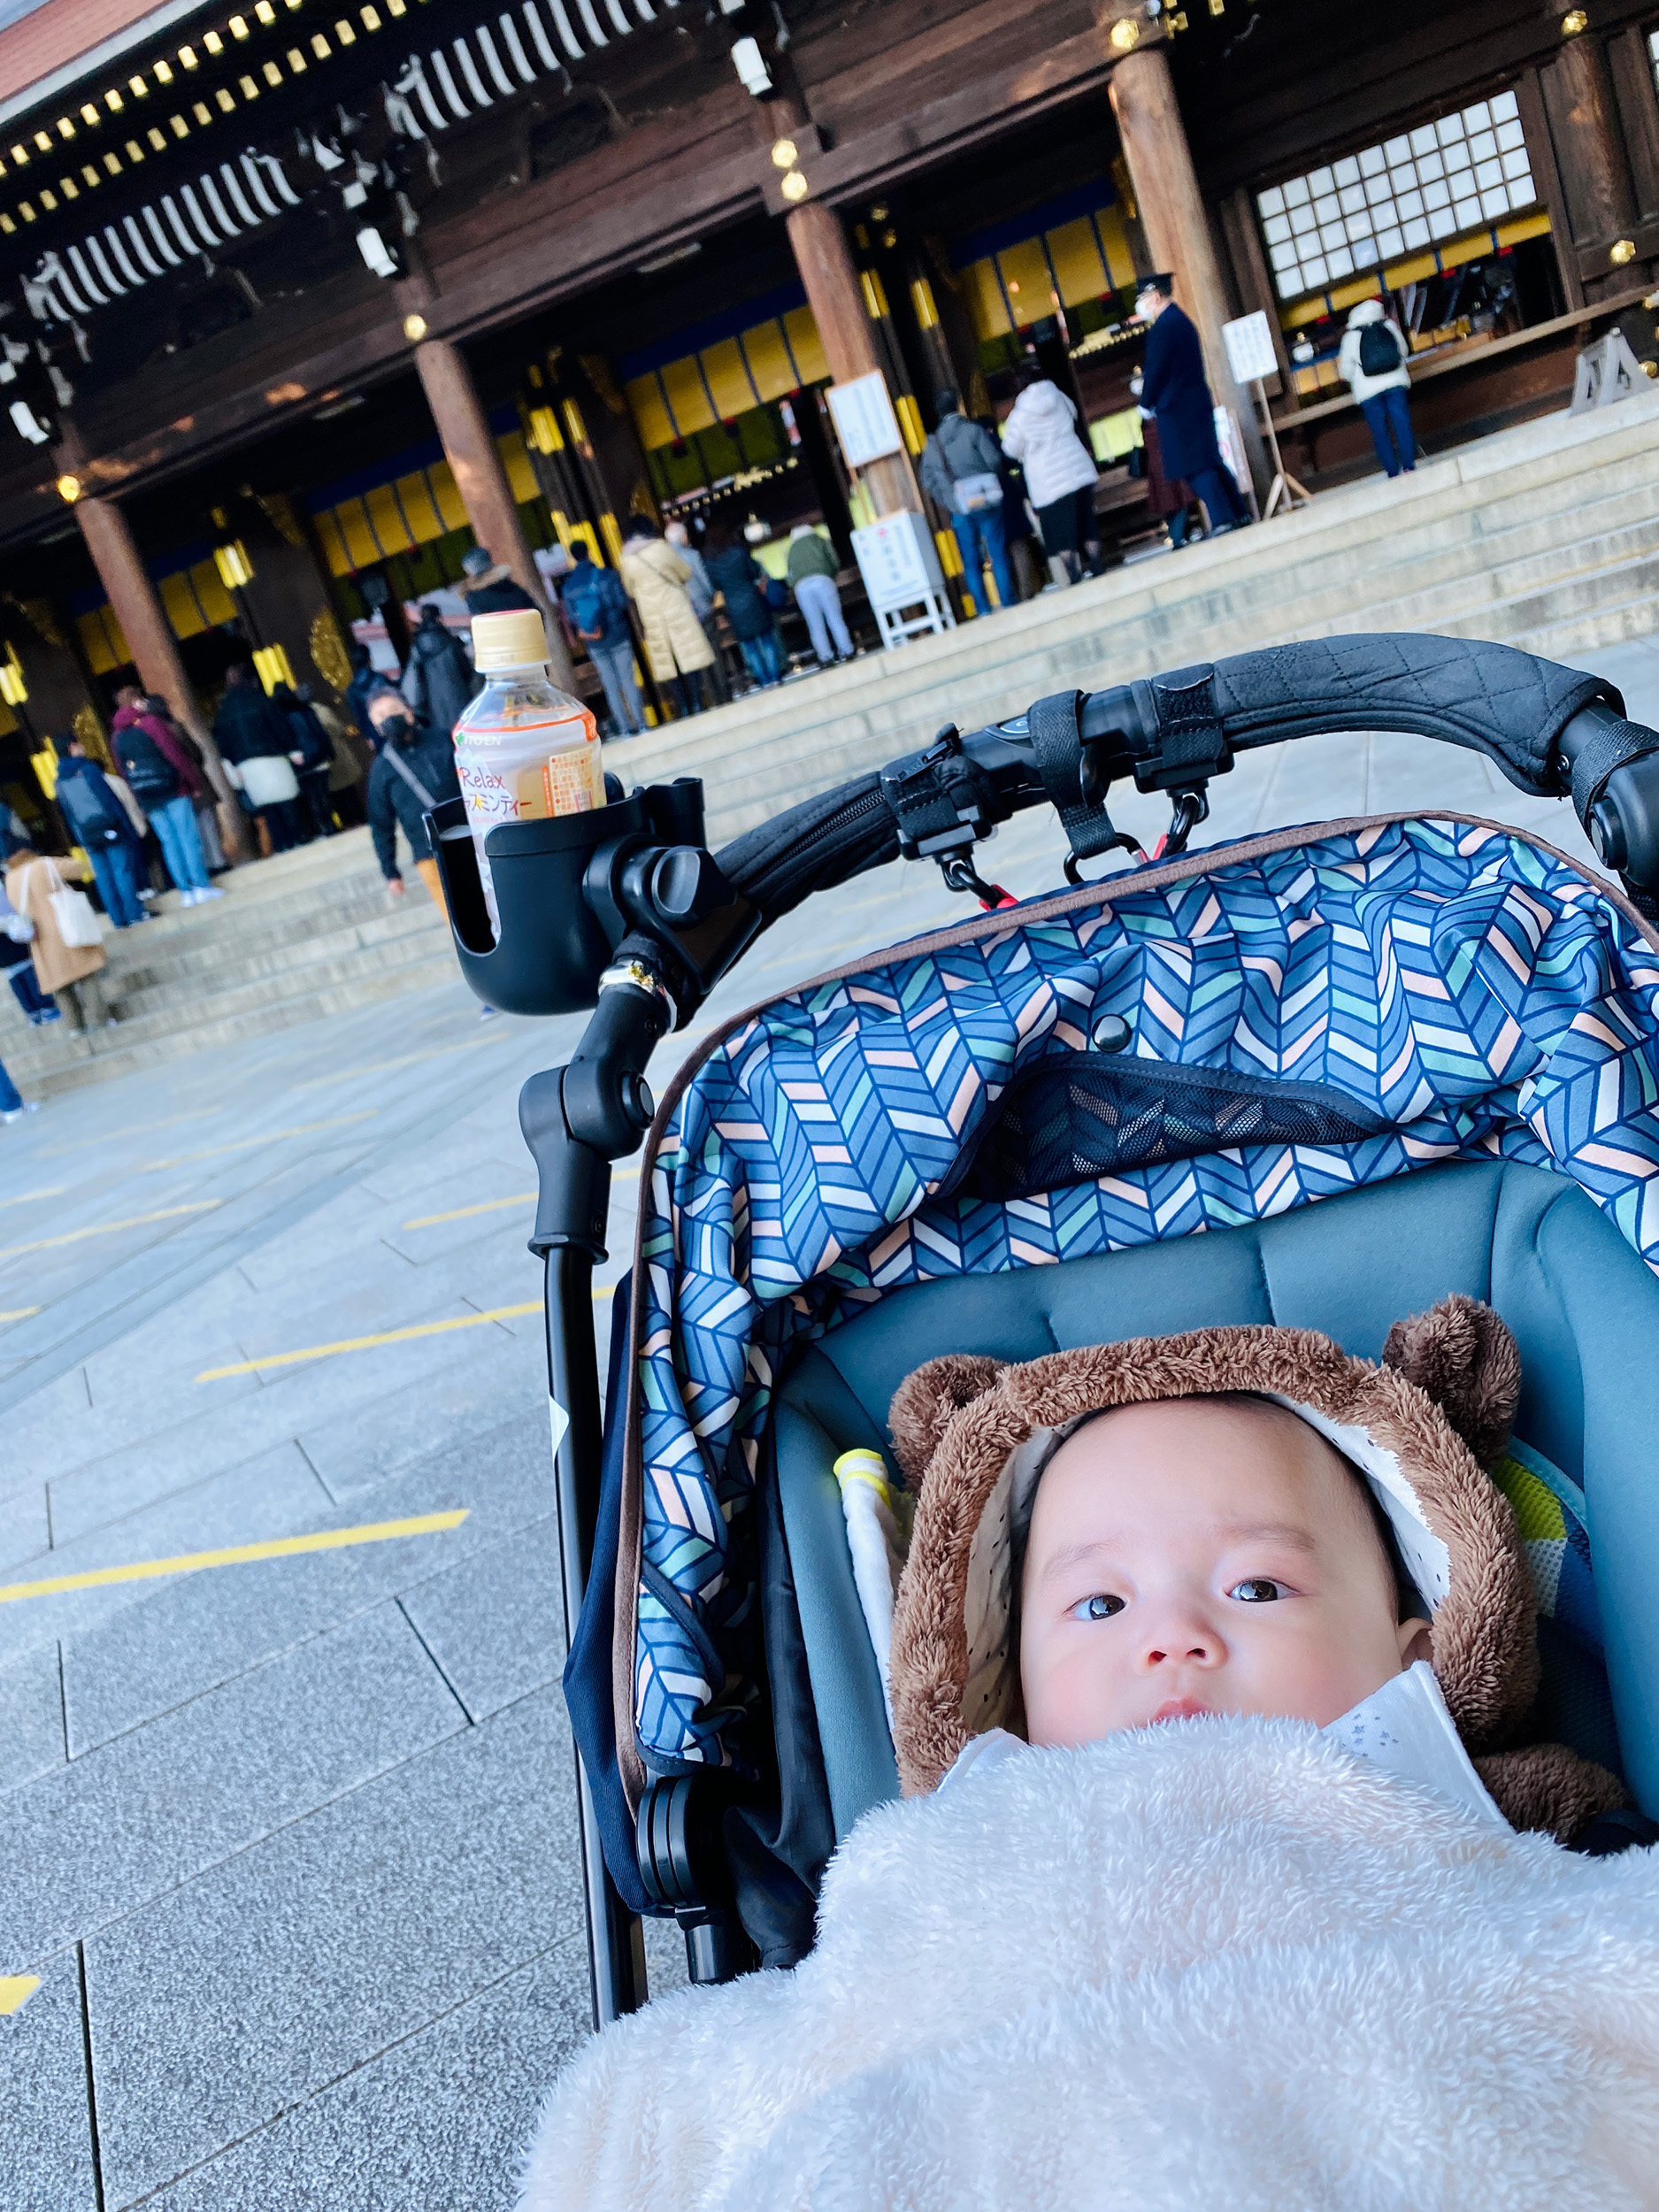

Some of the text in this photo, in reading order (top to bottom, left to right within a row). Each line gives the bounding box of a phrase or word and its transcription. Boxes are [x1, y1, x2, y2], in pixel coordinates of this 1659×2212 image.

[464, 735, 502, 746] ITO EN
[460, 766, 505, 789] Relax
